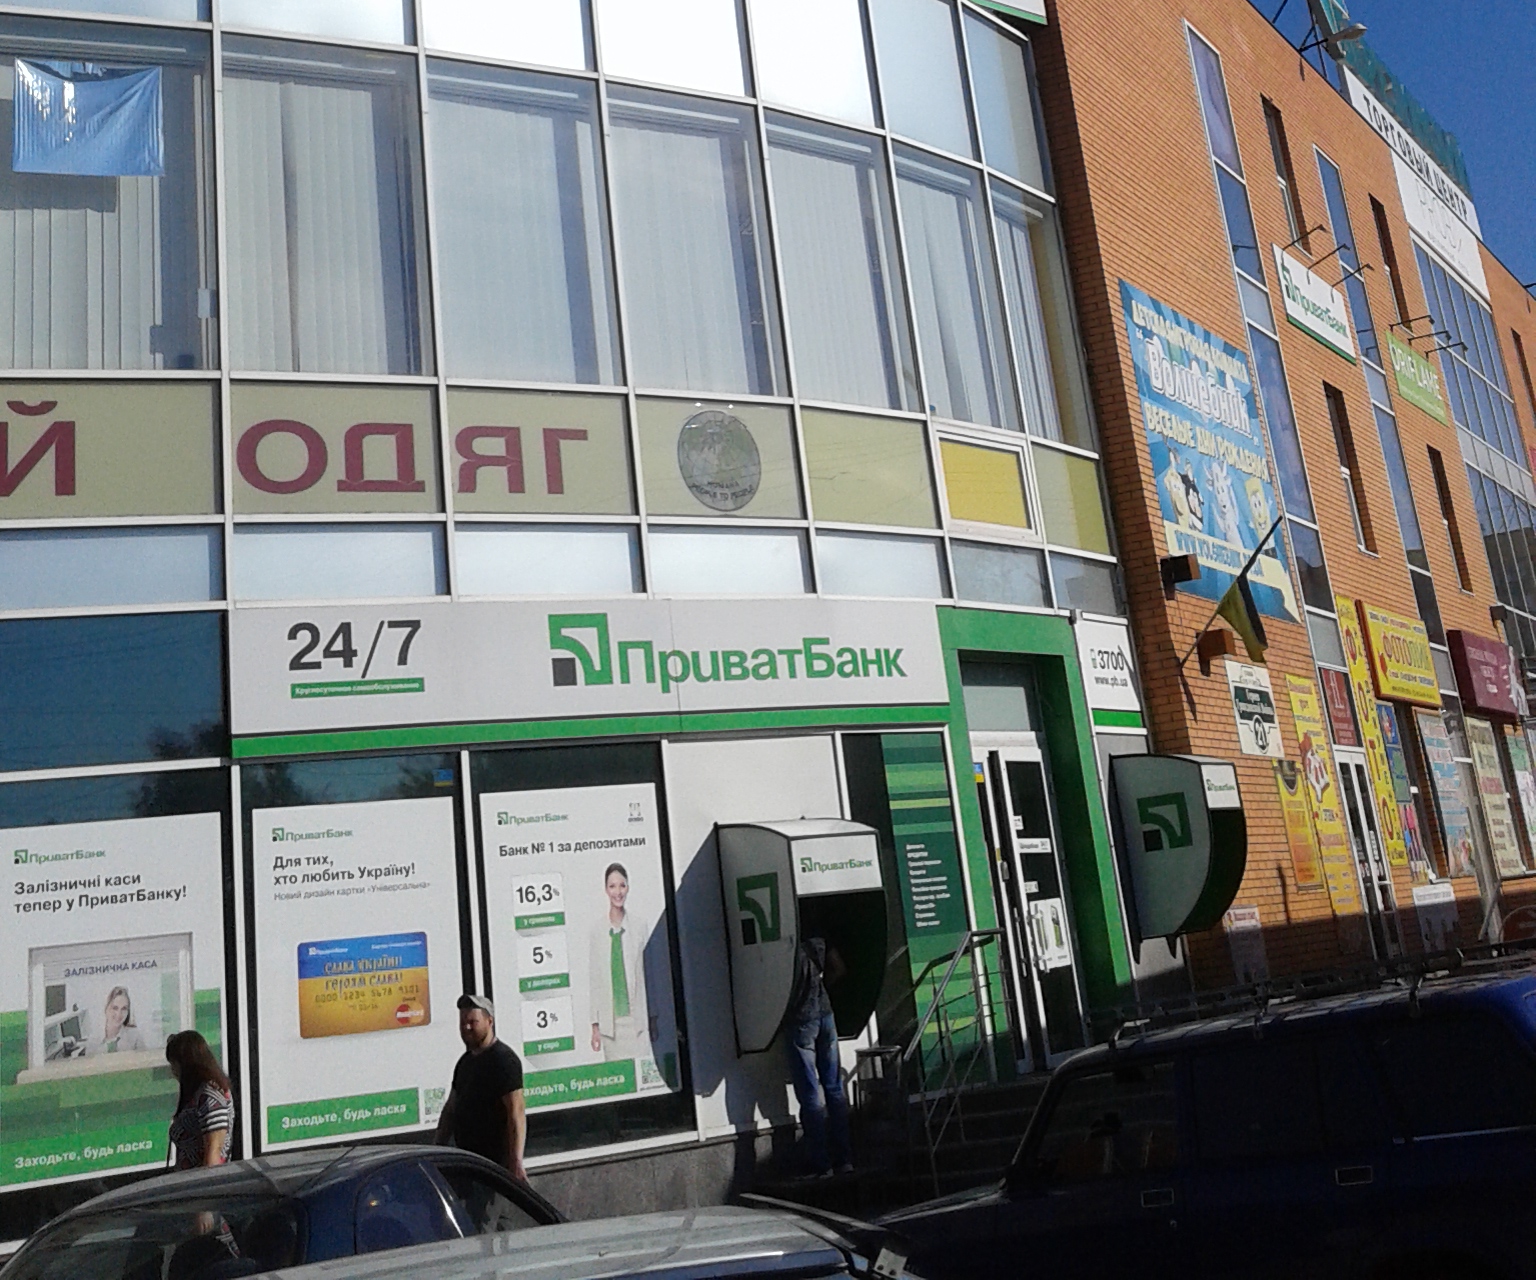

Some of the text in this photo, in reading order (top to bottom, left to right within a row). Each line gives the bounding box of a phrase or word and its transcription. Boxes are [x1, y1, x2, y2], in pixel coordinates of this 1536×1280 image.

[1362, 93, 1433, 187] ТОРГОВЫЙ
[236, 419, 589, 495] ОДЯГ
[287, 619, 422, 679] 24/7
[617, 637, 909, 693] ПриватБанк
[1098, 650, 1125, 671] 3700
[1093, 675, 1129, 688] www.pb.ua
[285, 829, 354, 843] ПриватБанк
[29, 849, 106, 865] ПриватБанк
[499, 837, 647, 857] Банк № 1 за депозитами
[273, 855, 334, 870] Для тих,
[813, 859, 873, 874] ПриватБанк
[14, 873, 141, 895] Залізничні каси
[273, 862, 416, 886] хто любить Україну!
[14, 885, 188, 913] тепер у ПриватБанку!
[274, 890, 302, 901] Новий
[303, 888, 335, 900] дизайн
[336, 886, 366, 898] картки
[64, 959, 158, 978] ЗАЛІЗНИЧНА КАСА
[536, 1010, 559, 1029] 3%
[523, 1074, 625, 1097] аходьте, будь ласка
[281, 1102, 407, 1130] Заходьте, будь ласка
[14, 1139, 153, 1169] Заходьте, будь ласка
